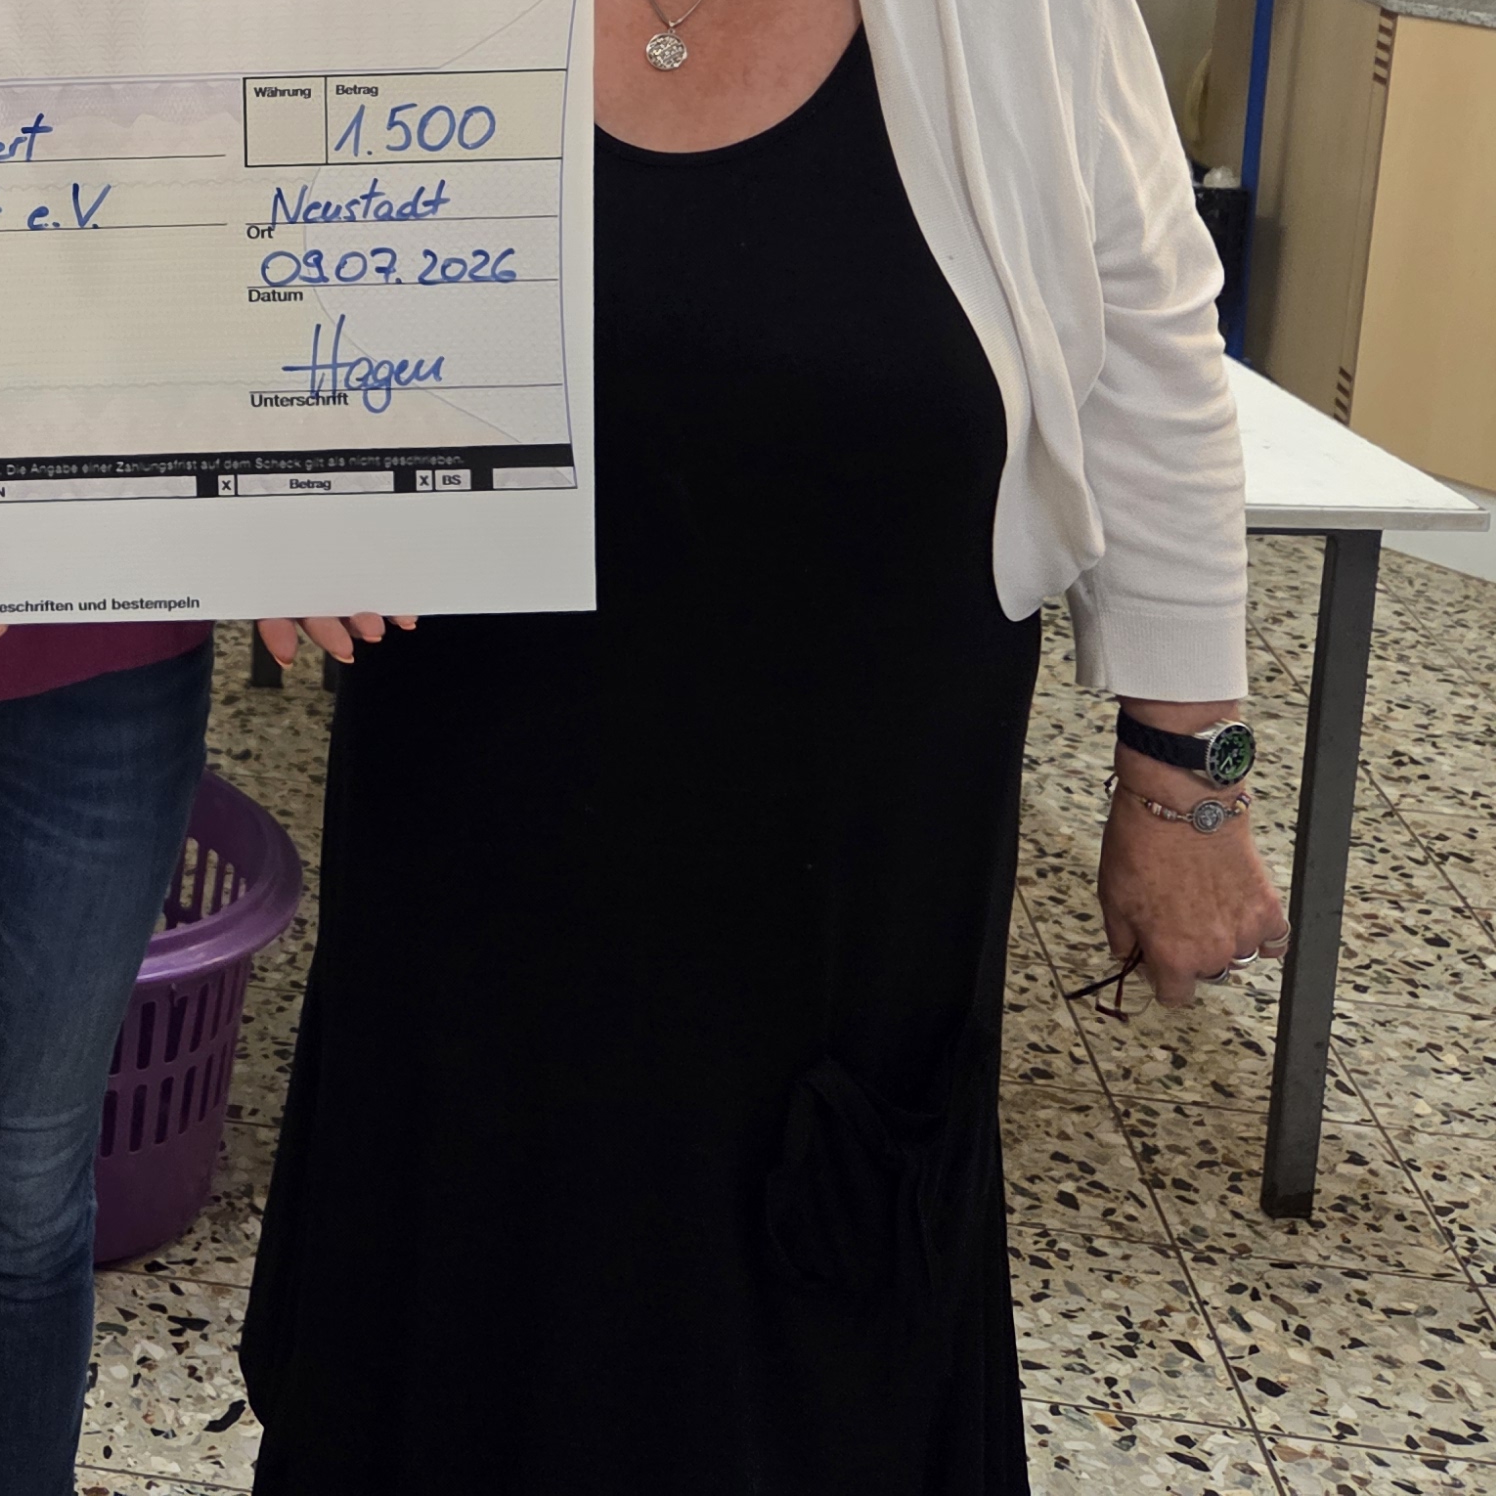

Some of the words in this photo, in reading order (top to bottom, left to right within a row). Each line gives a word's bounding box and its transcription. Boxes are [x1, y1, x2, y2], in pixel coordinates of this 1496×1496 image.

[253, 86, 311, 100] Währung
[335, 84, 379, 97] Betrag
[334, 103, 496, 157] 1.500
[271, 178, 451, 232] Neustadt
[247, 226, 274, 239] Ort
[248, 289, 303, 302] Datum
[251, 392, 348, 408] Unterschrift
[6, 464, 26, 476] Die
[30, 462, 77, 477] Angabe
[82, 462, 112, 474] einer
[115, 459, 198, 474] Zahlungsfrist
[201, 459, 220, 471] auf
[224, 458, 251, 469] dem
[255, 457, 302, 470] Scheck
[305, 457, 325, 471] gilt
[328, 455, 346, 467] als
[349, 455, 380, 467] nicht
[289, 478, 331, 490] Betrag
[442, 475, 461, 486] BS
[79, 599, 107, 611] und
[111, 596, 200, 611] bestempeln
